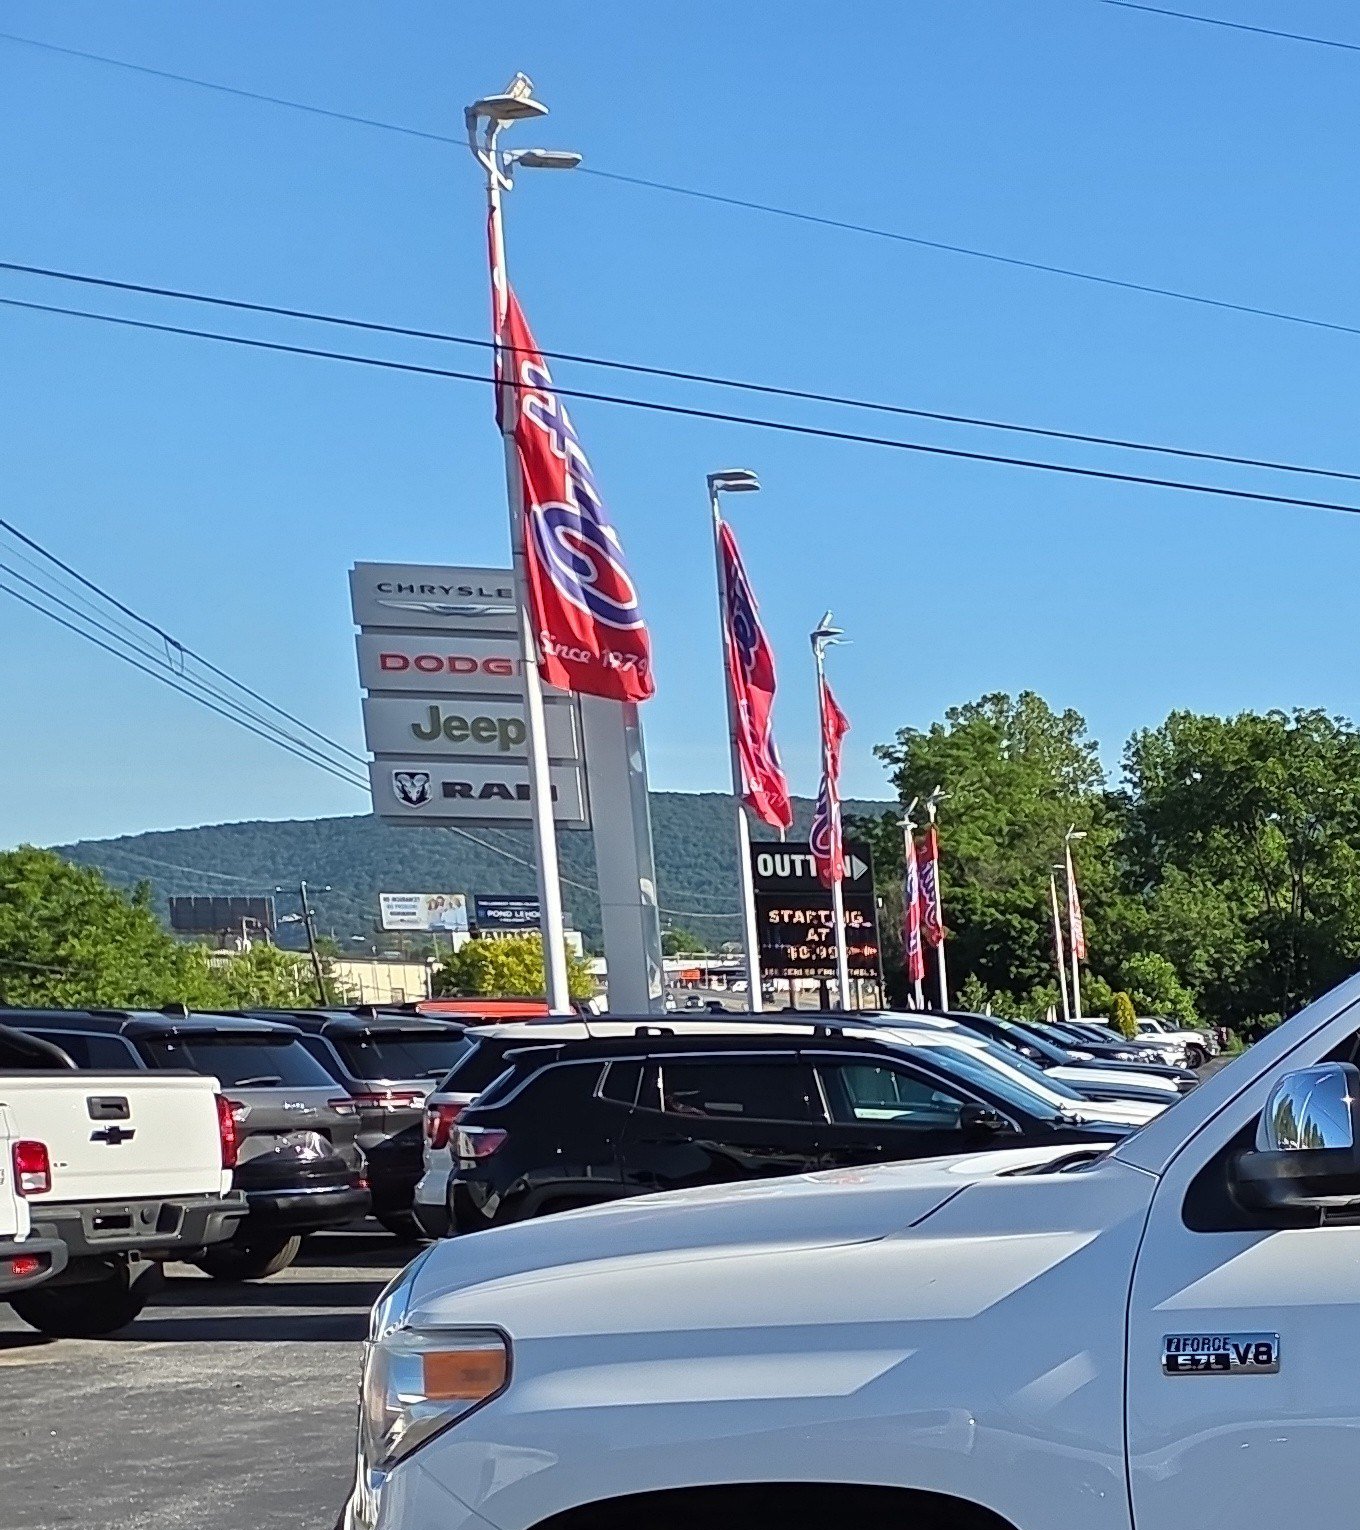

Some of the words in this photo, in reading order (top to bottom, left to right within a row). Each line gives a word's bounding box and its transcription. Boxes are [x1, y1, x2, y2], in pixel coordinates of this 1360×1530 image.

[376, 582, 513, 598] CHRYSLE
[379, 653, 523, 676] DODG
[411, 705, 526, 751] Jeep
[757, 853, 852, 878] OUTTN
[806, 927, 831, 942] AT
[1232, 1342, 1273, 1365] V8
